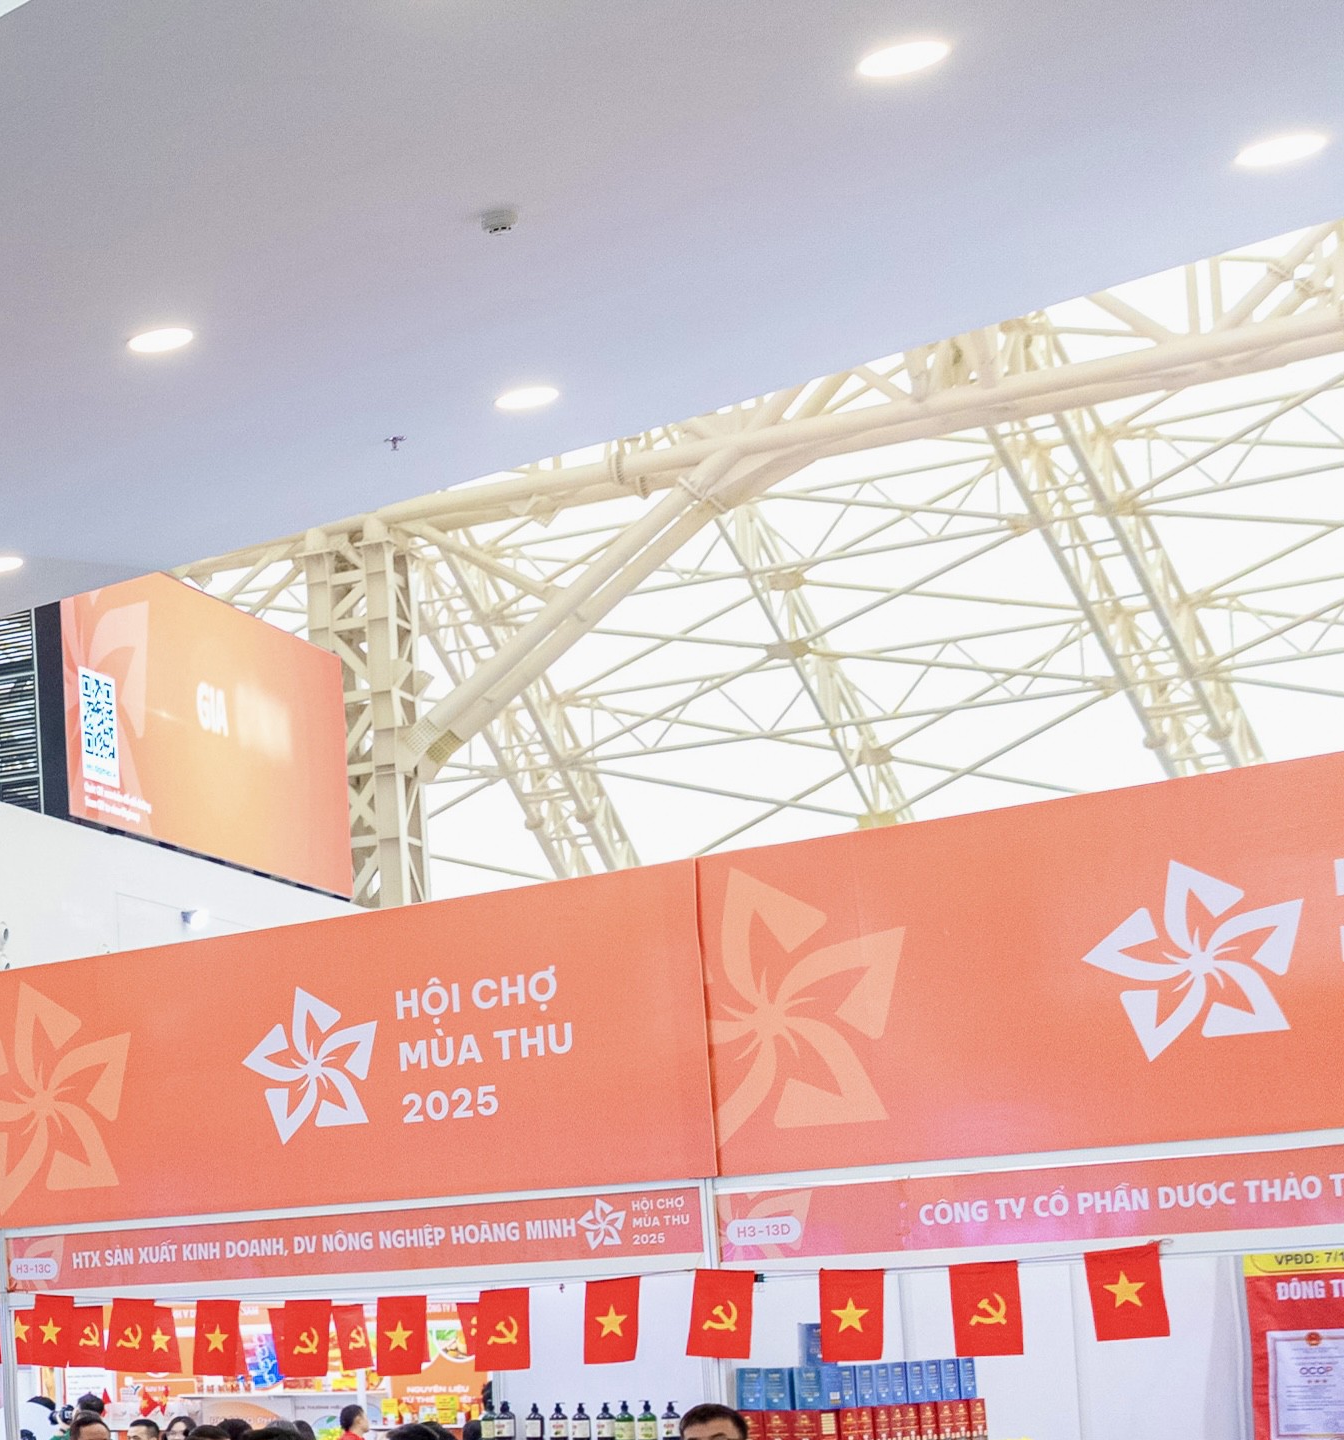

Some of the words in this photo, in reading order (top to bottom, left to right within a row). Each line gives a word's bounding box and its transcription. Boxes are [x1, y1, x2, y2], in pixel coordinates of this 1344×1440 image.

[196, 681, 229, 737] GIA
[395, 976, 460, 1025] HỘI
[471, 965, 557, 1012] CHỢ
[399, 1028, 484, 1072] MÙA
[493, 1022, 573, 1061] THU
[402, 1085, 499, 1124] 2025
[631, 1199, 654, 1212] HỘI
[657, 1196, 685, 1210] CHỢ
[918, 1199, 988, 1226] CÔNG
[995, 1197, 1026, 1220] TY
[1033, 1185, 1069, 1218] CỔ
[1077, 1182, 1149, 1215] PHẦN
[1158, 1181, 1236, 1211] DƯỢC
[1244, 1171, 1322, 1203] THẢO
[1329, 1173, 1344, 1197] T
[632, 1213, 660, 1229] MÙA
[663, 1213, 690, 1226] THU
[737, 1223, 791, 1238] H3-13D
[73, 1251, 101, 1269] HTX
[105, 1243, 134, 1267] SẢN
[138, 1239, 176, 1264] XUẤT
[183, 1241, 220, 1261] KINH
[225, 1237, 288, 1259] DOANH,
[293, 1235, 316, 1255] DV
[322, 1229, 373, 1252] NÔNG
[379, 1223, 445, 1249] NGHIỆP
[451, 1219, 519, 1244] HOÀNG
[525, 1217, 576, 1239] MINH
[632, 1233, 665, 1246] 2025
[1324, 1251, 1344, 1263] 7/1
[16, 1261, 51, 1274] H3-13C
[1300, 1366, 1333, 1375] OCOP
